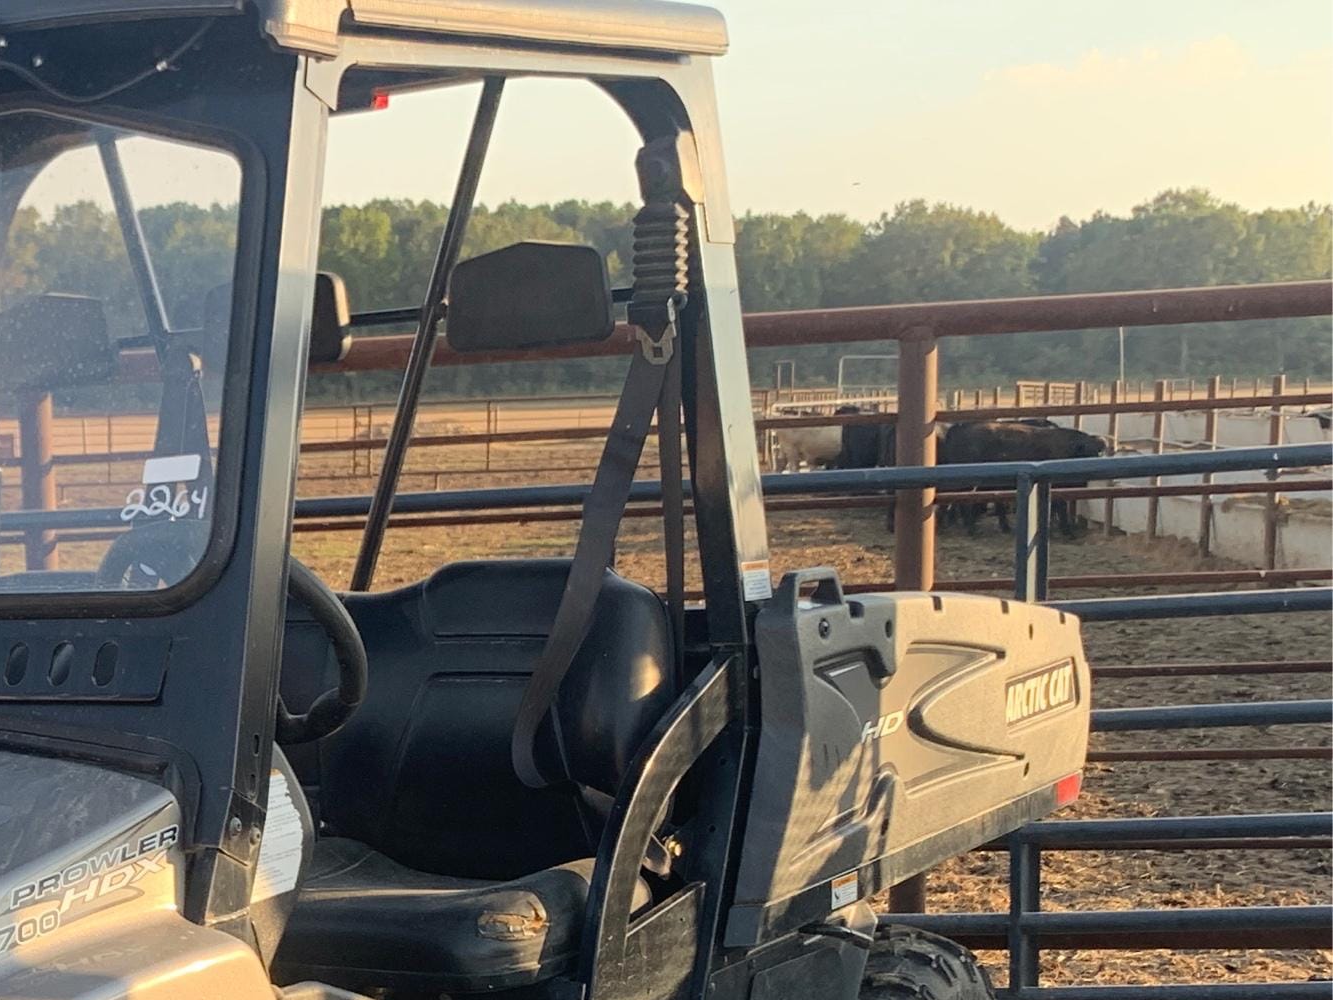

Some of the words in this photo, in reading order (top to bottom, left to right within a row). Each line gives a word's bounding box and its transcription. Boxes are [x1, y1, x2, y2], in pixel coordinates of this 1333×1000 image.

[120, 485, 208, 521] 2264
[1005, 672, 1049, 721] ARCTIC
[1049, 664, 1072, 706] CAT
[861, 710, 903, 744] HD
[10, 825, 179, 909] PROWLER
[59, 850, 169, 914] HDX
